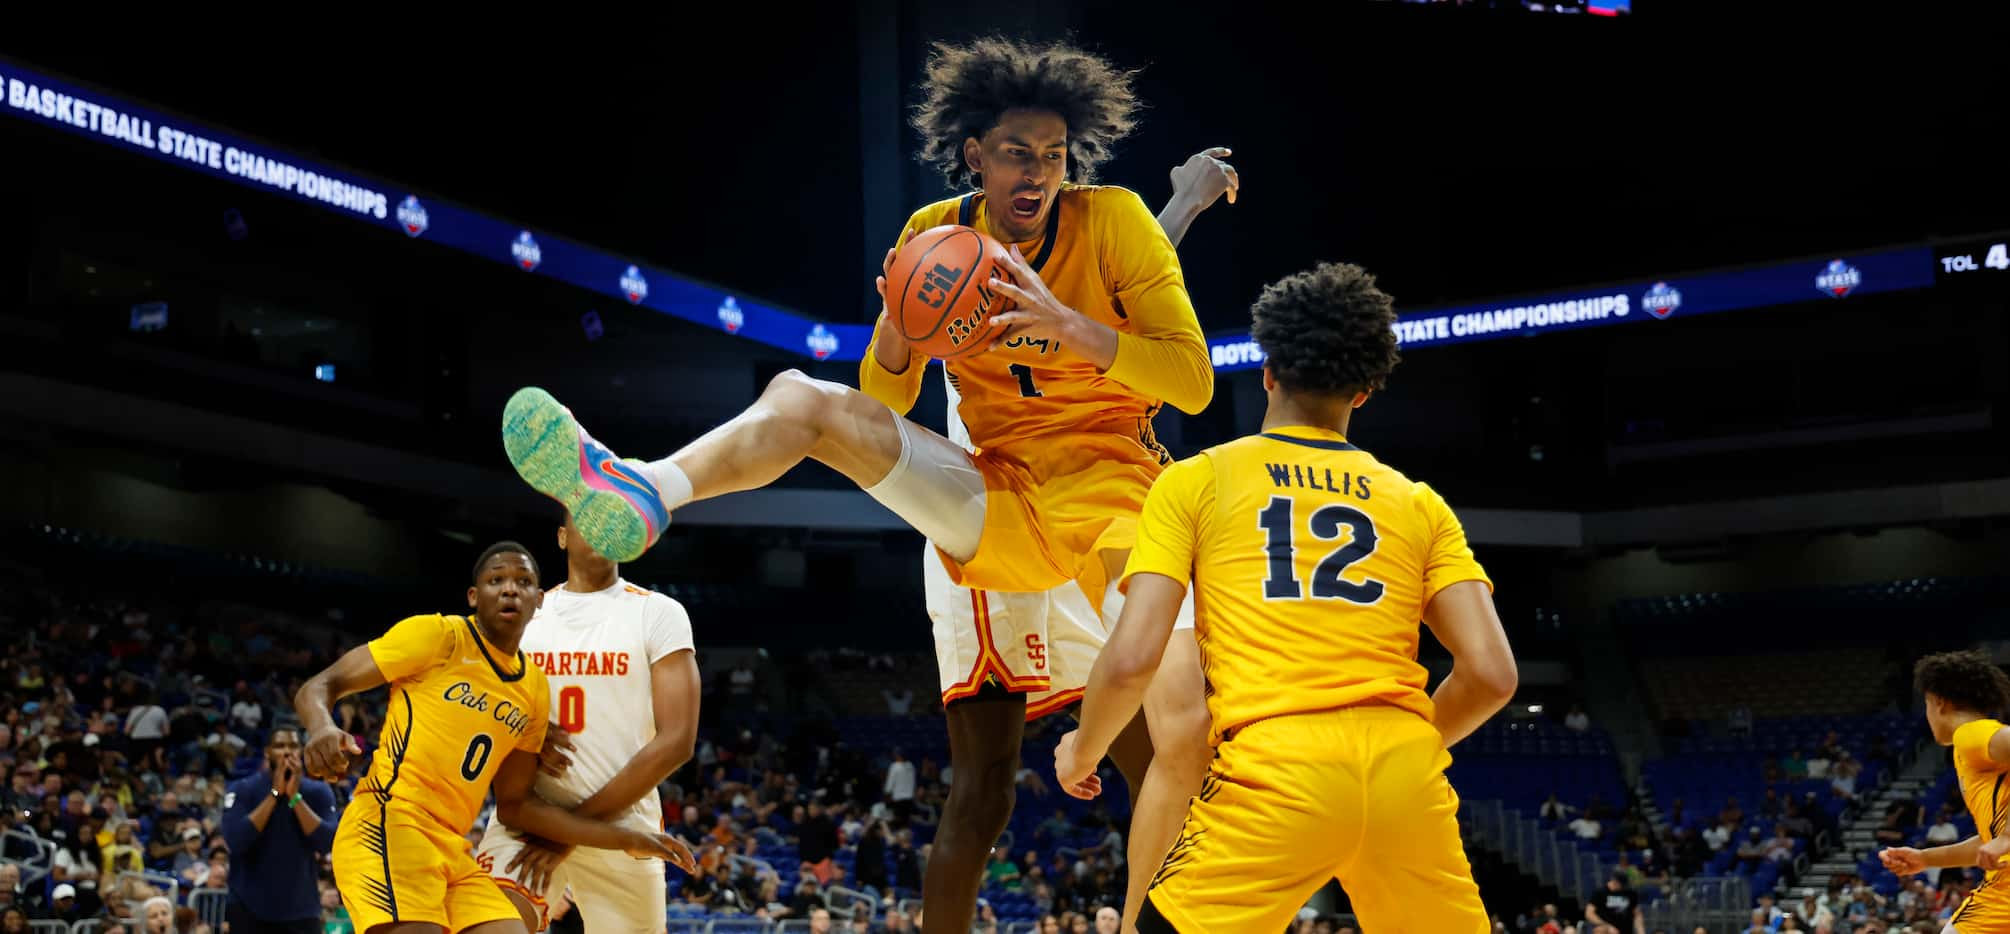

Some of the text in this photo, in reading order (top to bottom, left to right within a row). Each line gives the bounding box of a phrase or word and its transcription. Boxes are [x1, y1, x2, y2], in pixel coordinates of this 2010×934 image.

[9, 78, 388, 219] BASKETBALL STATE CHAMPIONSHIPS
[1941, 243, 2010, 273] TOL 4
[1392, 317, 1449, 345] STATE
[1451, 294, 1629, 336] CHAMPIONSHIPS
[1008, 363, 1043, 398] 1
[1265, 463, 1372, 500] WILLIS
[1258, 494, 1387, 605] 12
[527, 651, 630, 676] PARTANS
[443, 681, 530, 739] Oak Cliff
[559, 685, 586, 734] 0
[460, 733, 493, 782] 0
